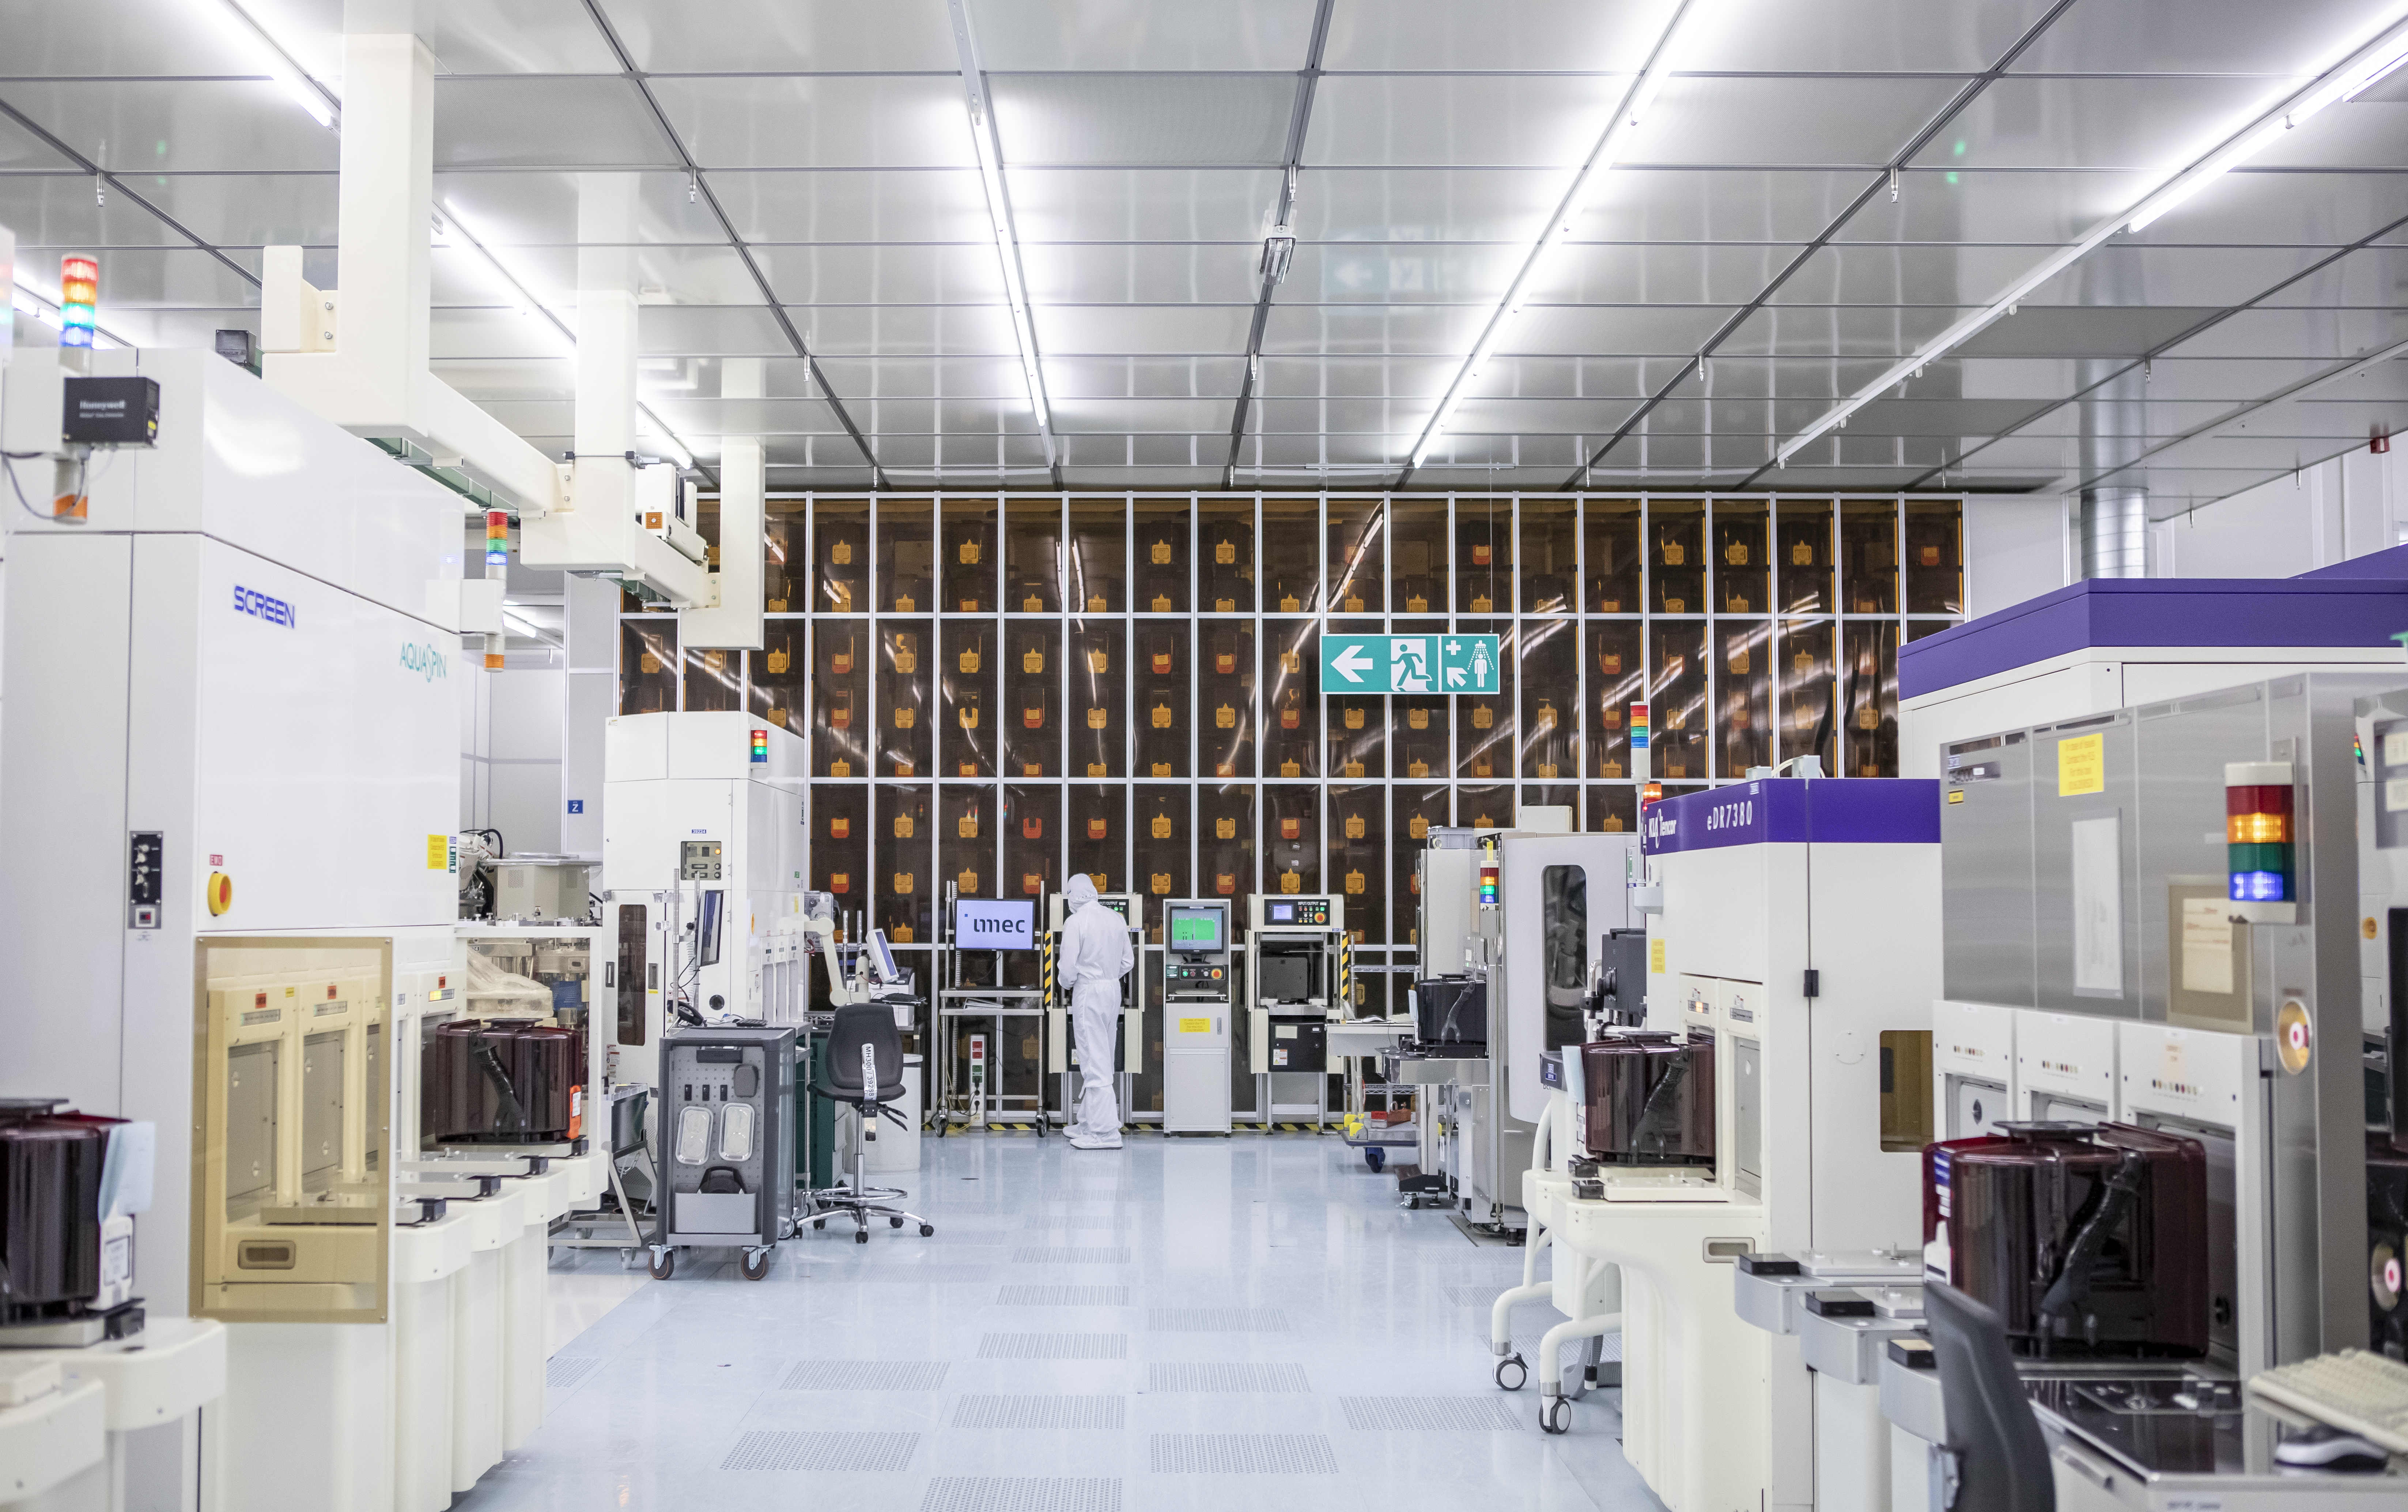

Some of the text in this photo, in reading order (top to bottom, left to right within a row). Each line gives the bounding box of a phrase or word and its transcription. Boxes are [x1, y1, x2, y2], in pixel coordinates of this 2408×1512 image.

[234, 586, 295, 629] SCREEN
[572, 804, 578, 812] Z
[1707, 800, 1752, 831] eDR7380
[974, 919, 1025, 933] imec
